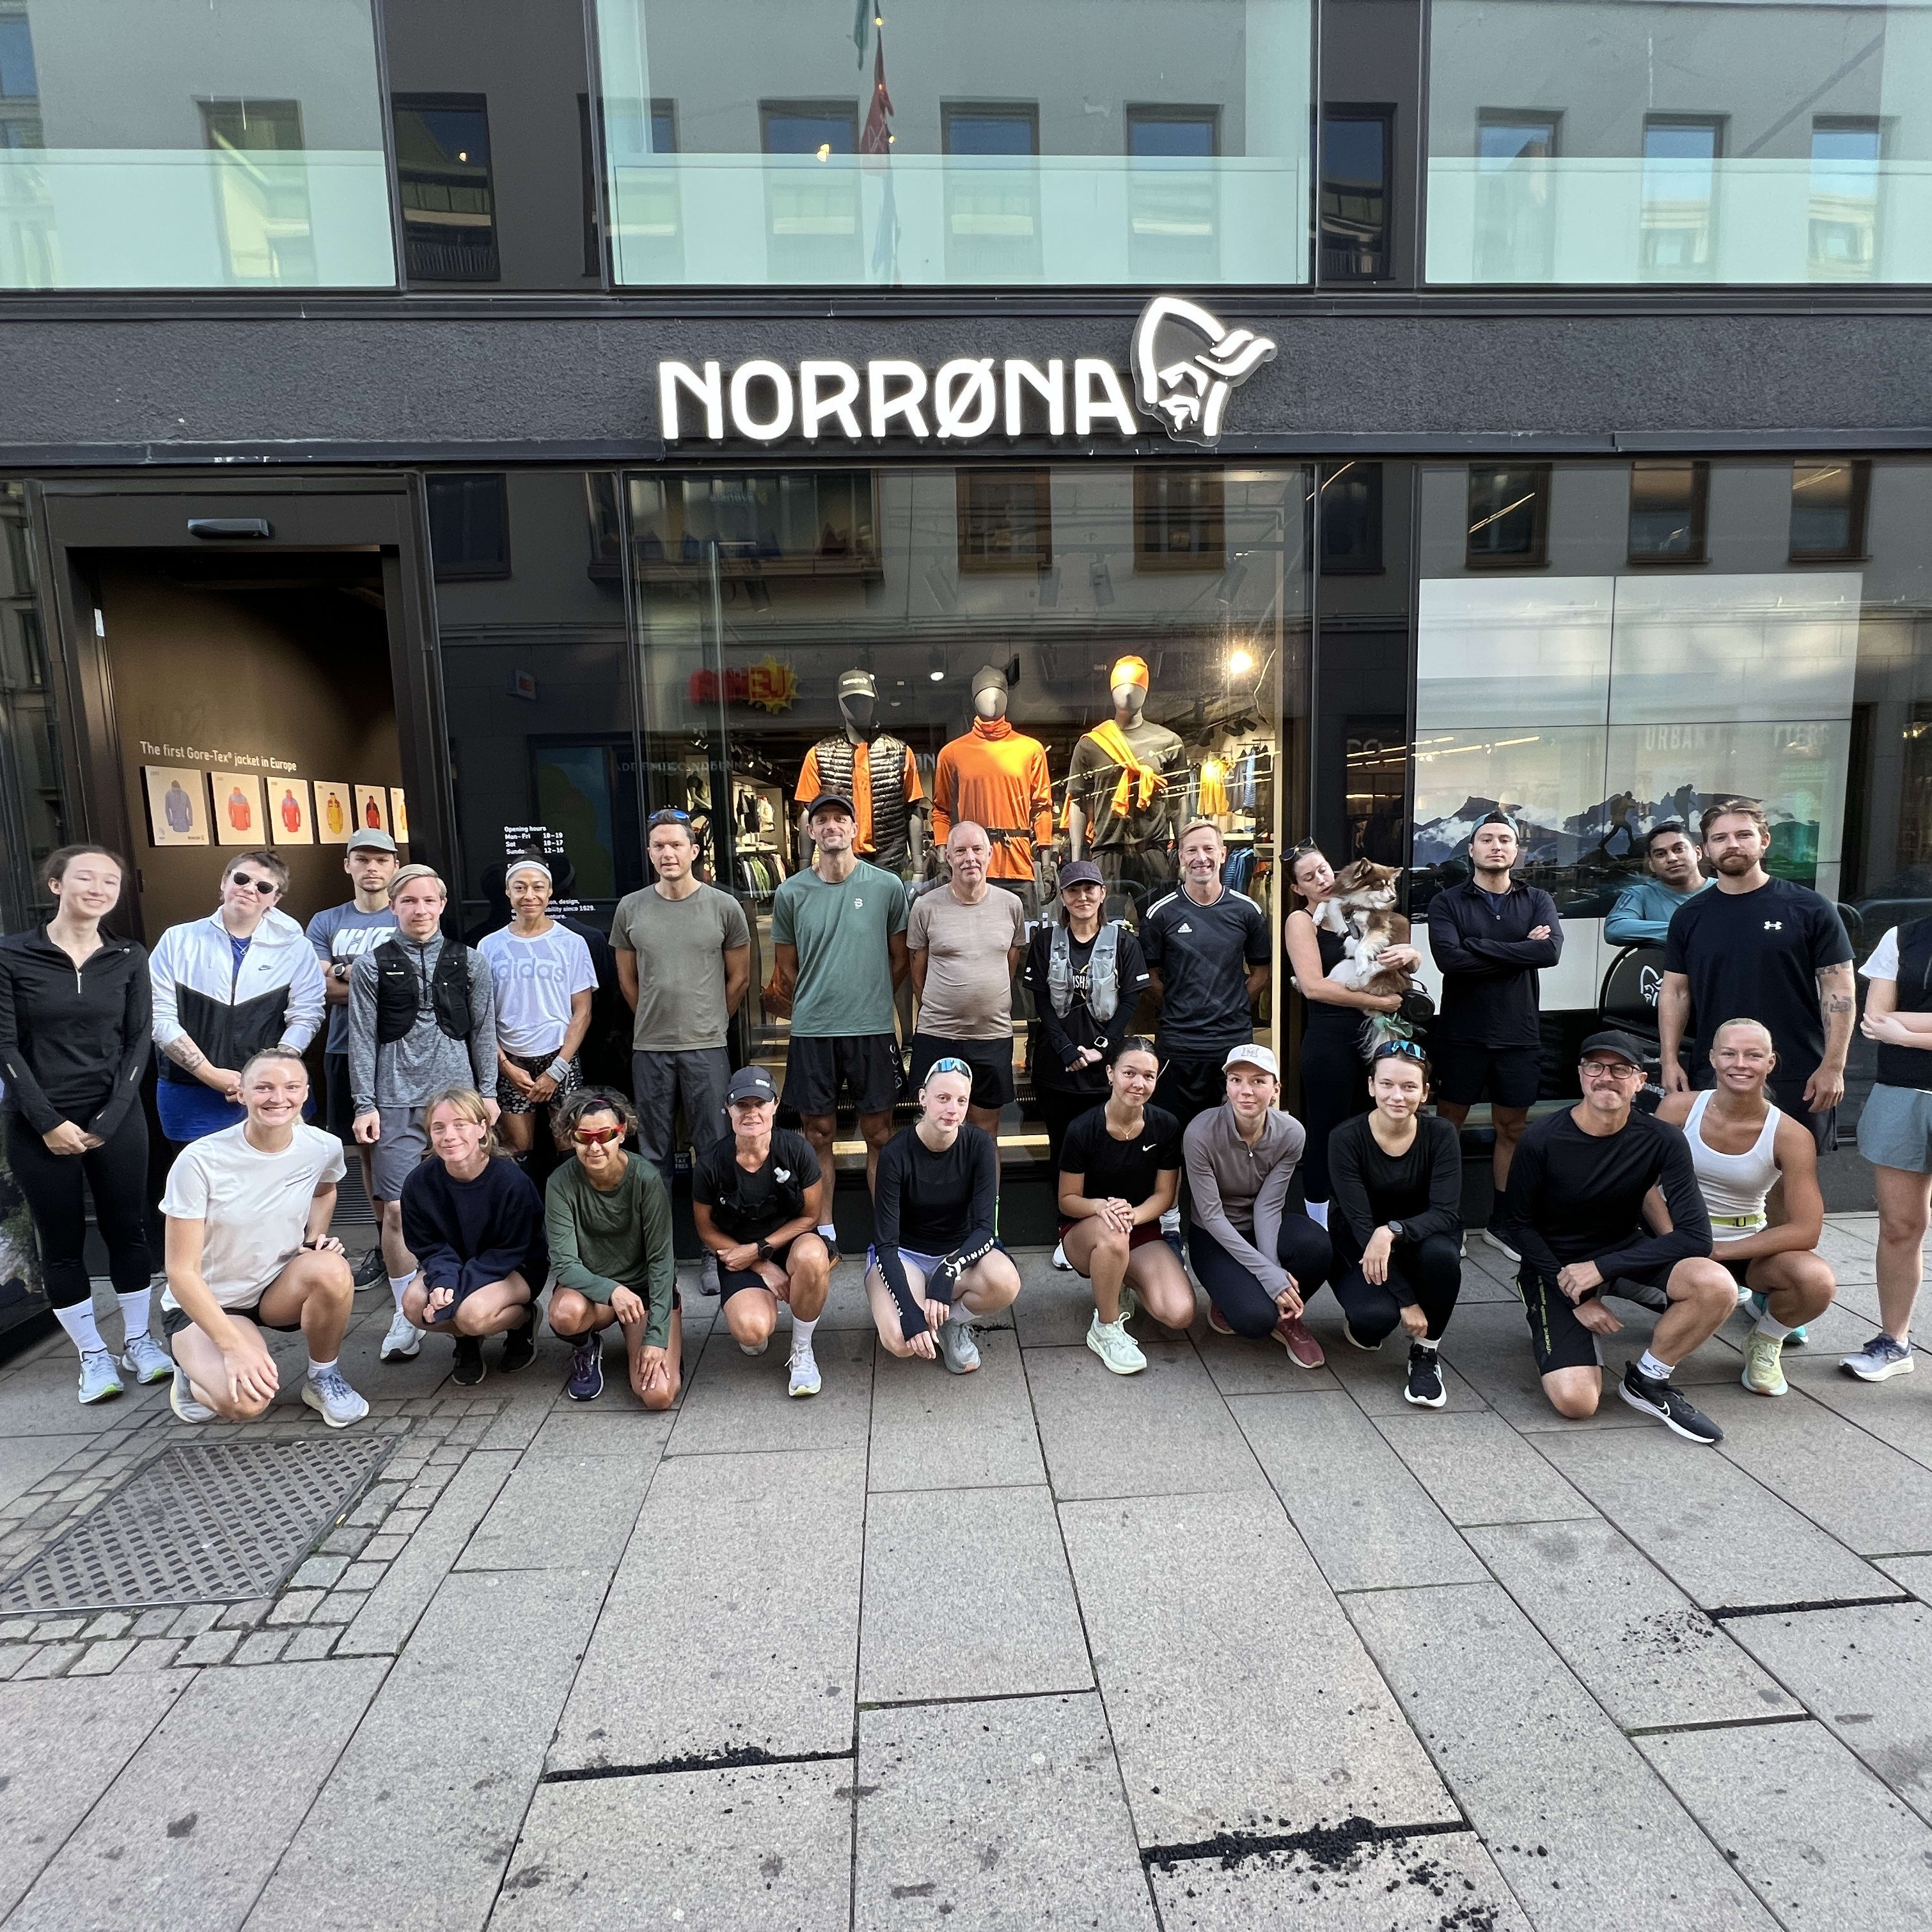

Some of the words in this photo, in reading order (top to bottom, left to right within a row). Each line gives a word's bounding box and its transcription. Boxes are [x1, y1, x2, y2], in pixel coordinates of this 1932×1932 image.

[659, 358, 1136, 439] NORRØNA
[139, 741, 161, 755] The
[164, 744, 185, 758] first
[234, 753, 260, 767] jacket
[261, 756, 269, 767] in
[270, 757, 297, 773] Europe
